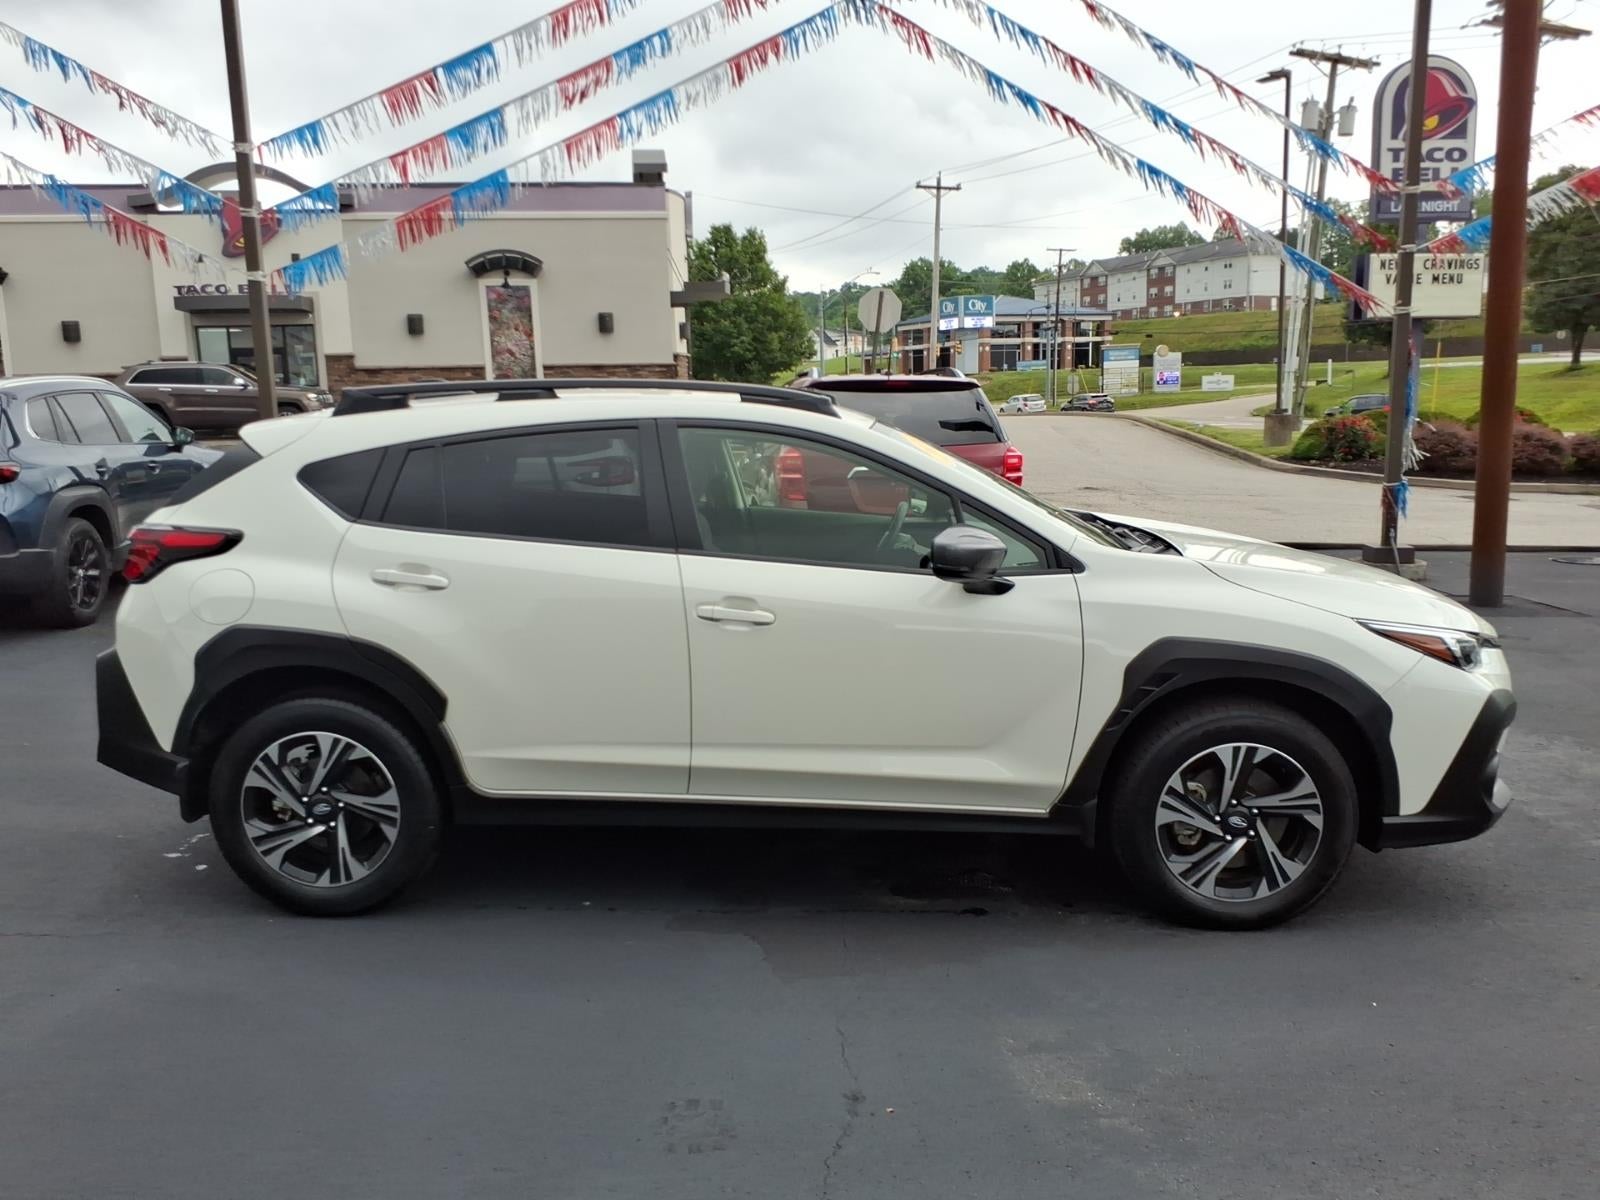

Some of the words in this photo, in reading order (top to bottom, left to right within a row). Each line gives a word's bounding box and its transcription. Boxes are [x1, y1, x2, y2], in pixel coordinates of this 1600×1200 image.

[1421, 201, 1459, 212] NIGHT
[1380, 259, 1399, 270] NE
[1423, 259, 1480, 270] CRAVINGS
[1432, 273, 1463, 285] MENU
[172, 284, 228, 296] TACO
[968, 299, 987, 313] City
